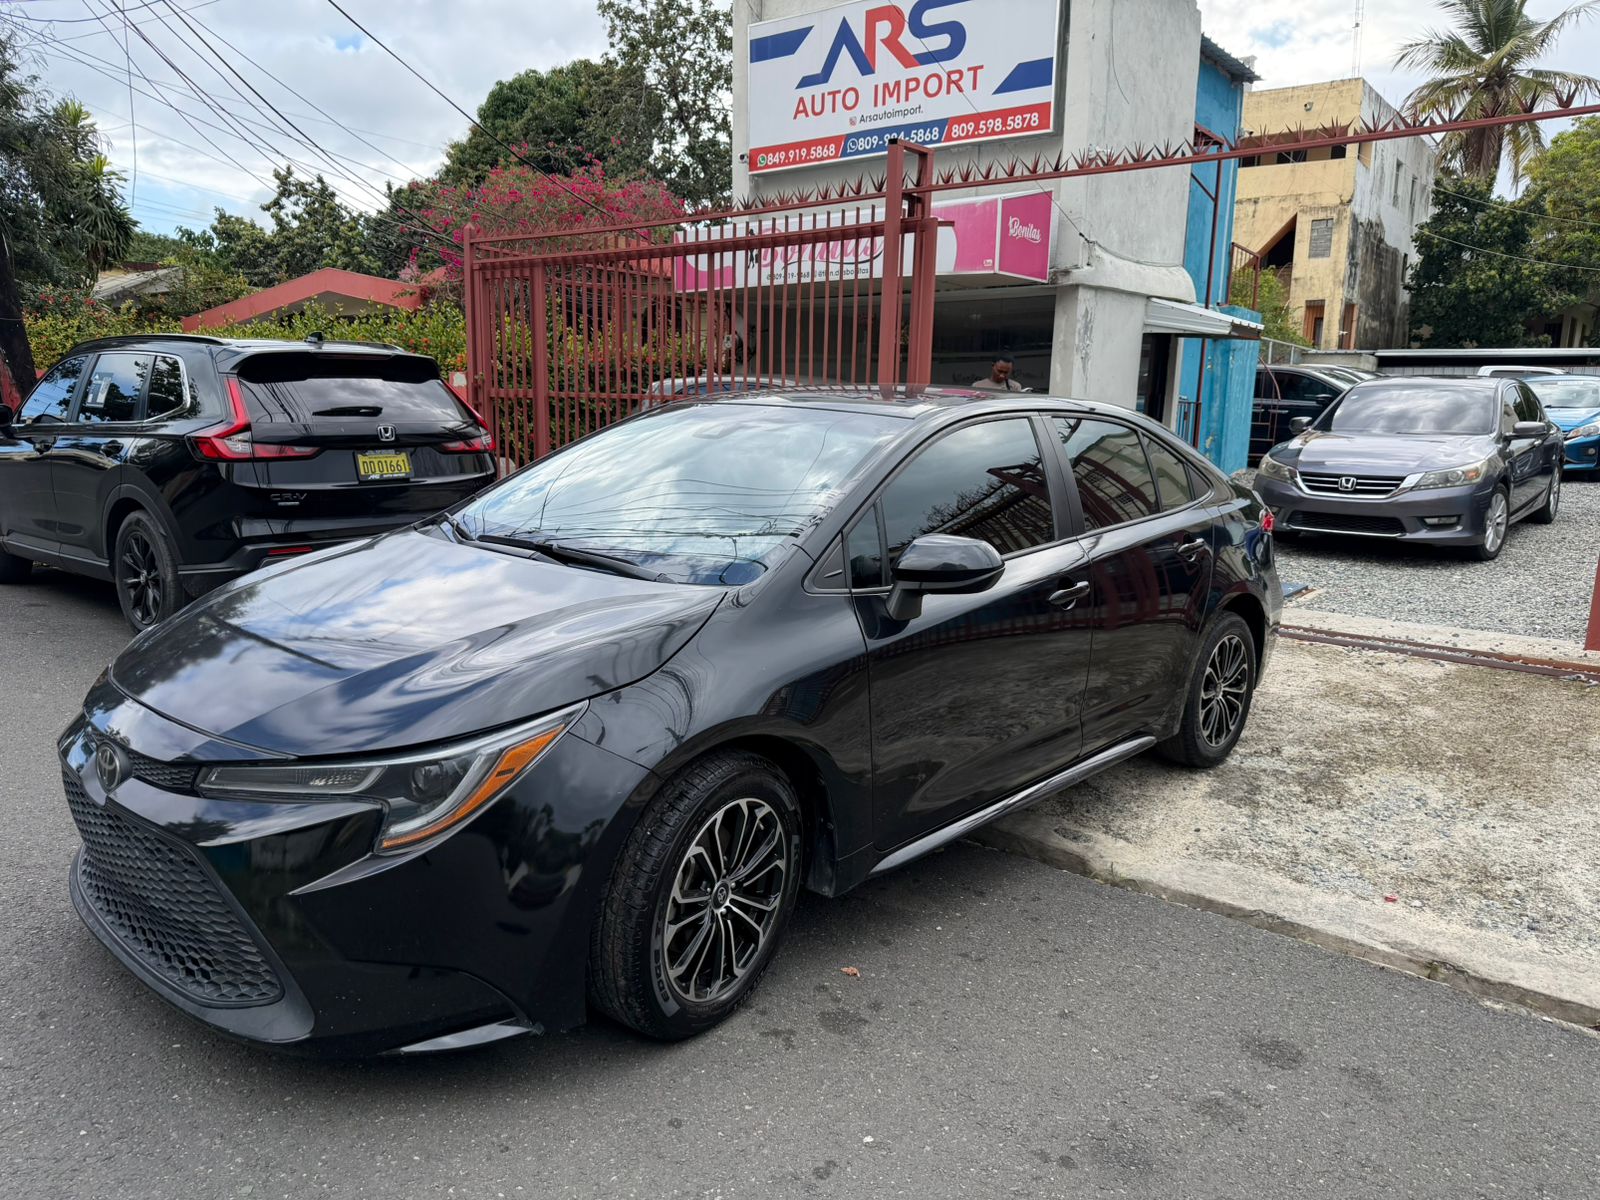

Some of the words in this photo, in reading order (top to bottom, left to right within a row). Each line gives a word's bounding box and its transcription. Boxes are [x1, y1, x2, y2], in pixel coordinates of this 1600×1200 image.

[795, 0, 971, 90] ARS
[793, 86, 860, 120] AUTO
[873, 65, 985, 108] IMPORT
[766, 144, 836, 166] 849.919.5868
[951, 112, 1040, 138] 809.598.5878
